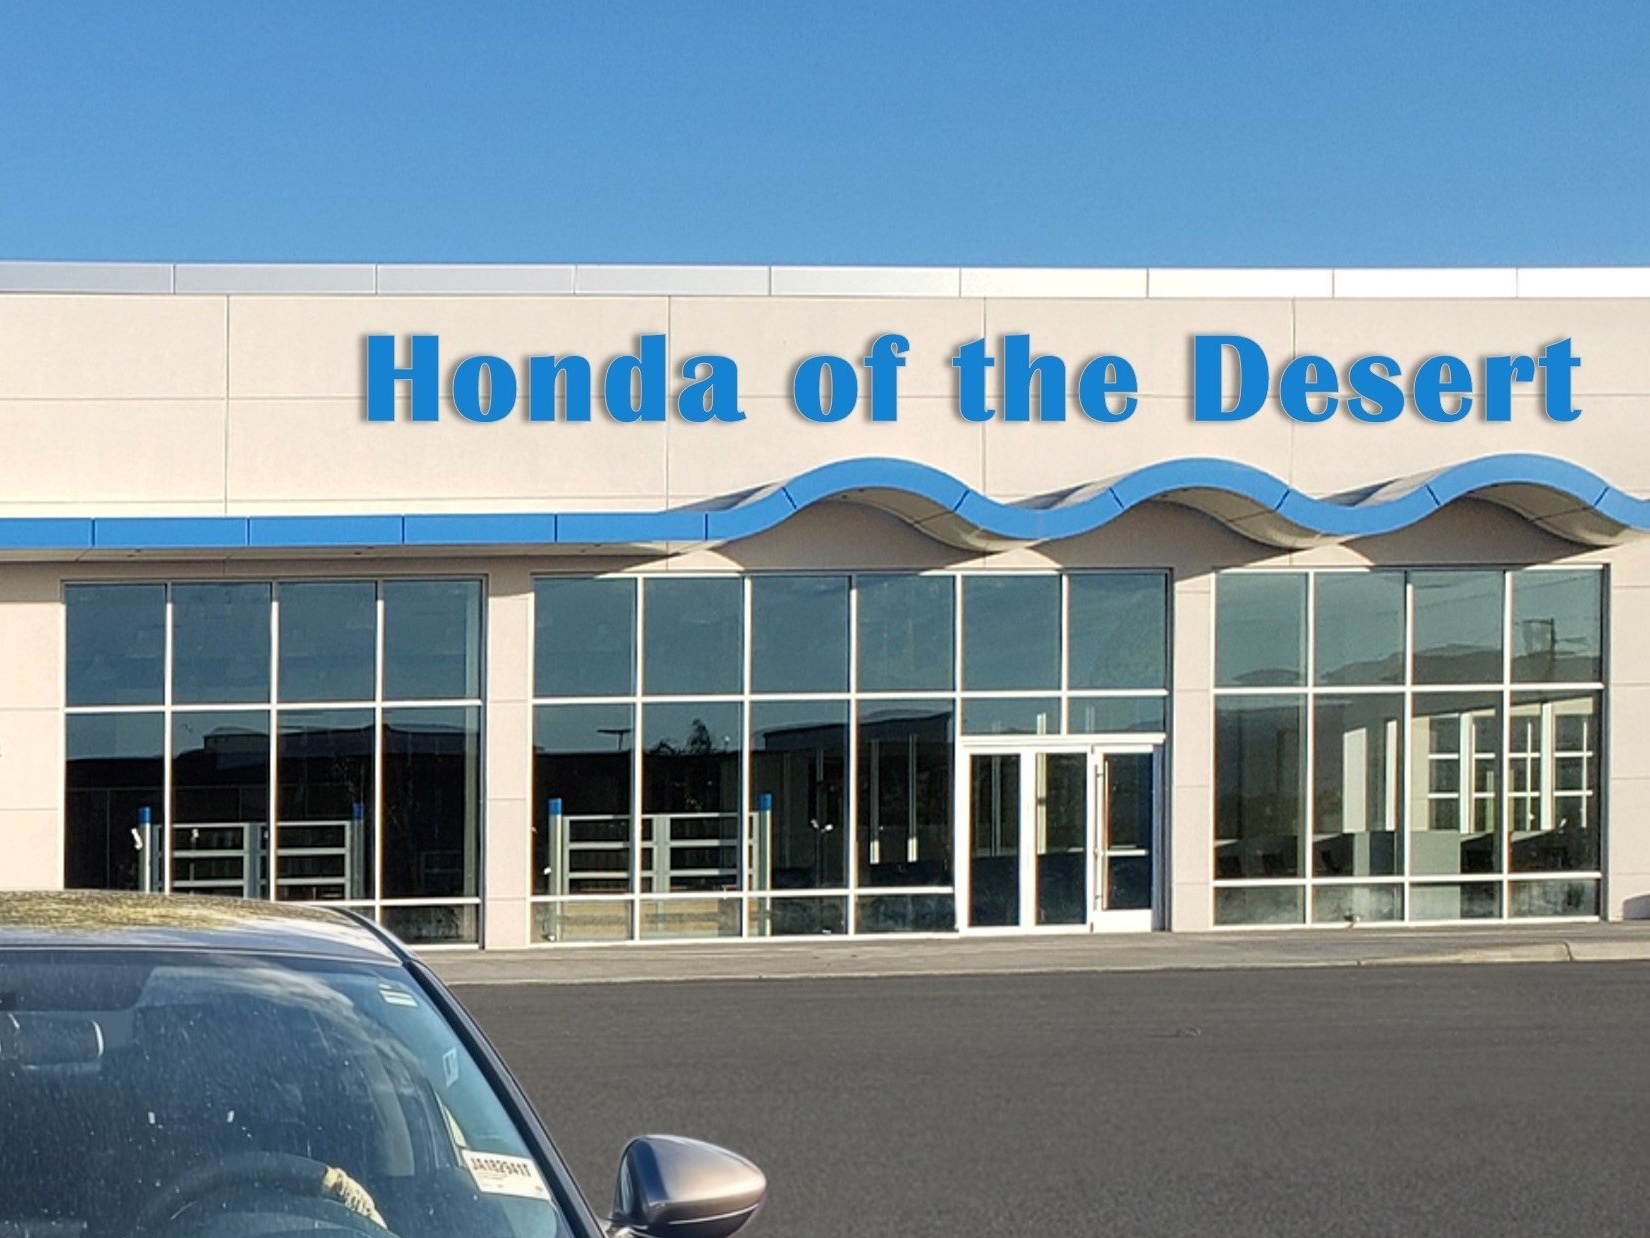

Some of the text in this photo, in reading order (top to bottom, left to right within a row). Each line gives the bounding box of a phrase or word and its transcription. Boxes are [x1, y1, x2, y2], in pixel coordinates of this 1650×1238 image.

[368, 333, 1582, 423] Honda of the Desert
